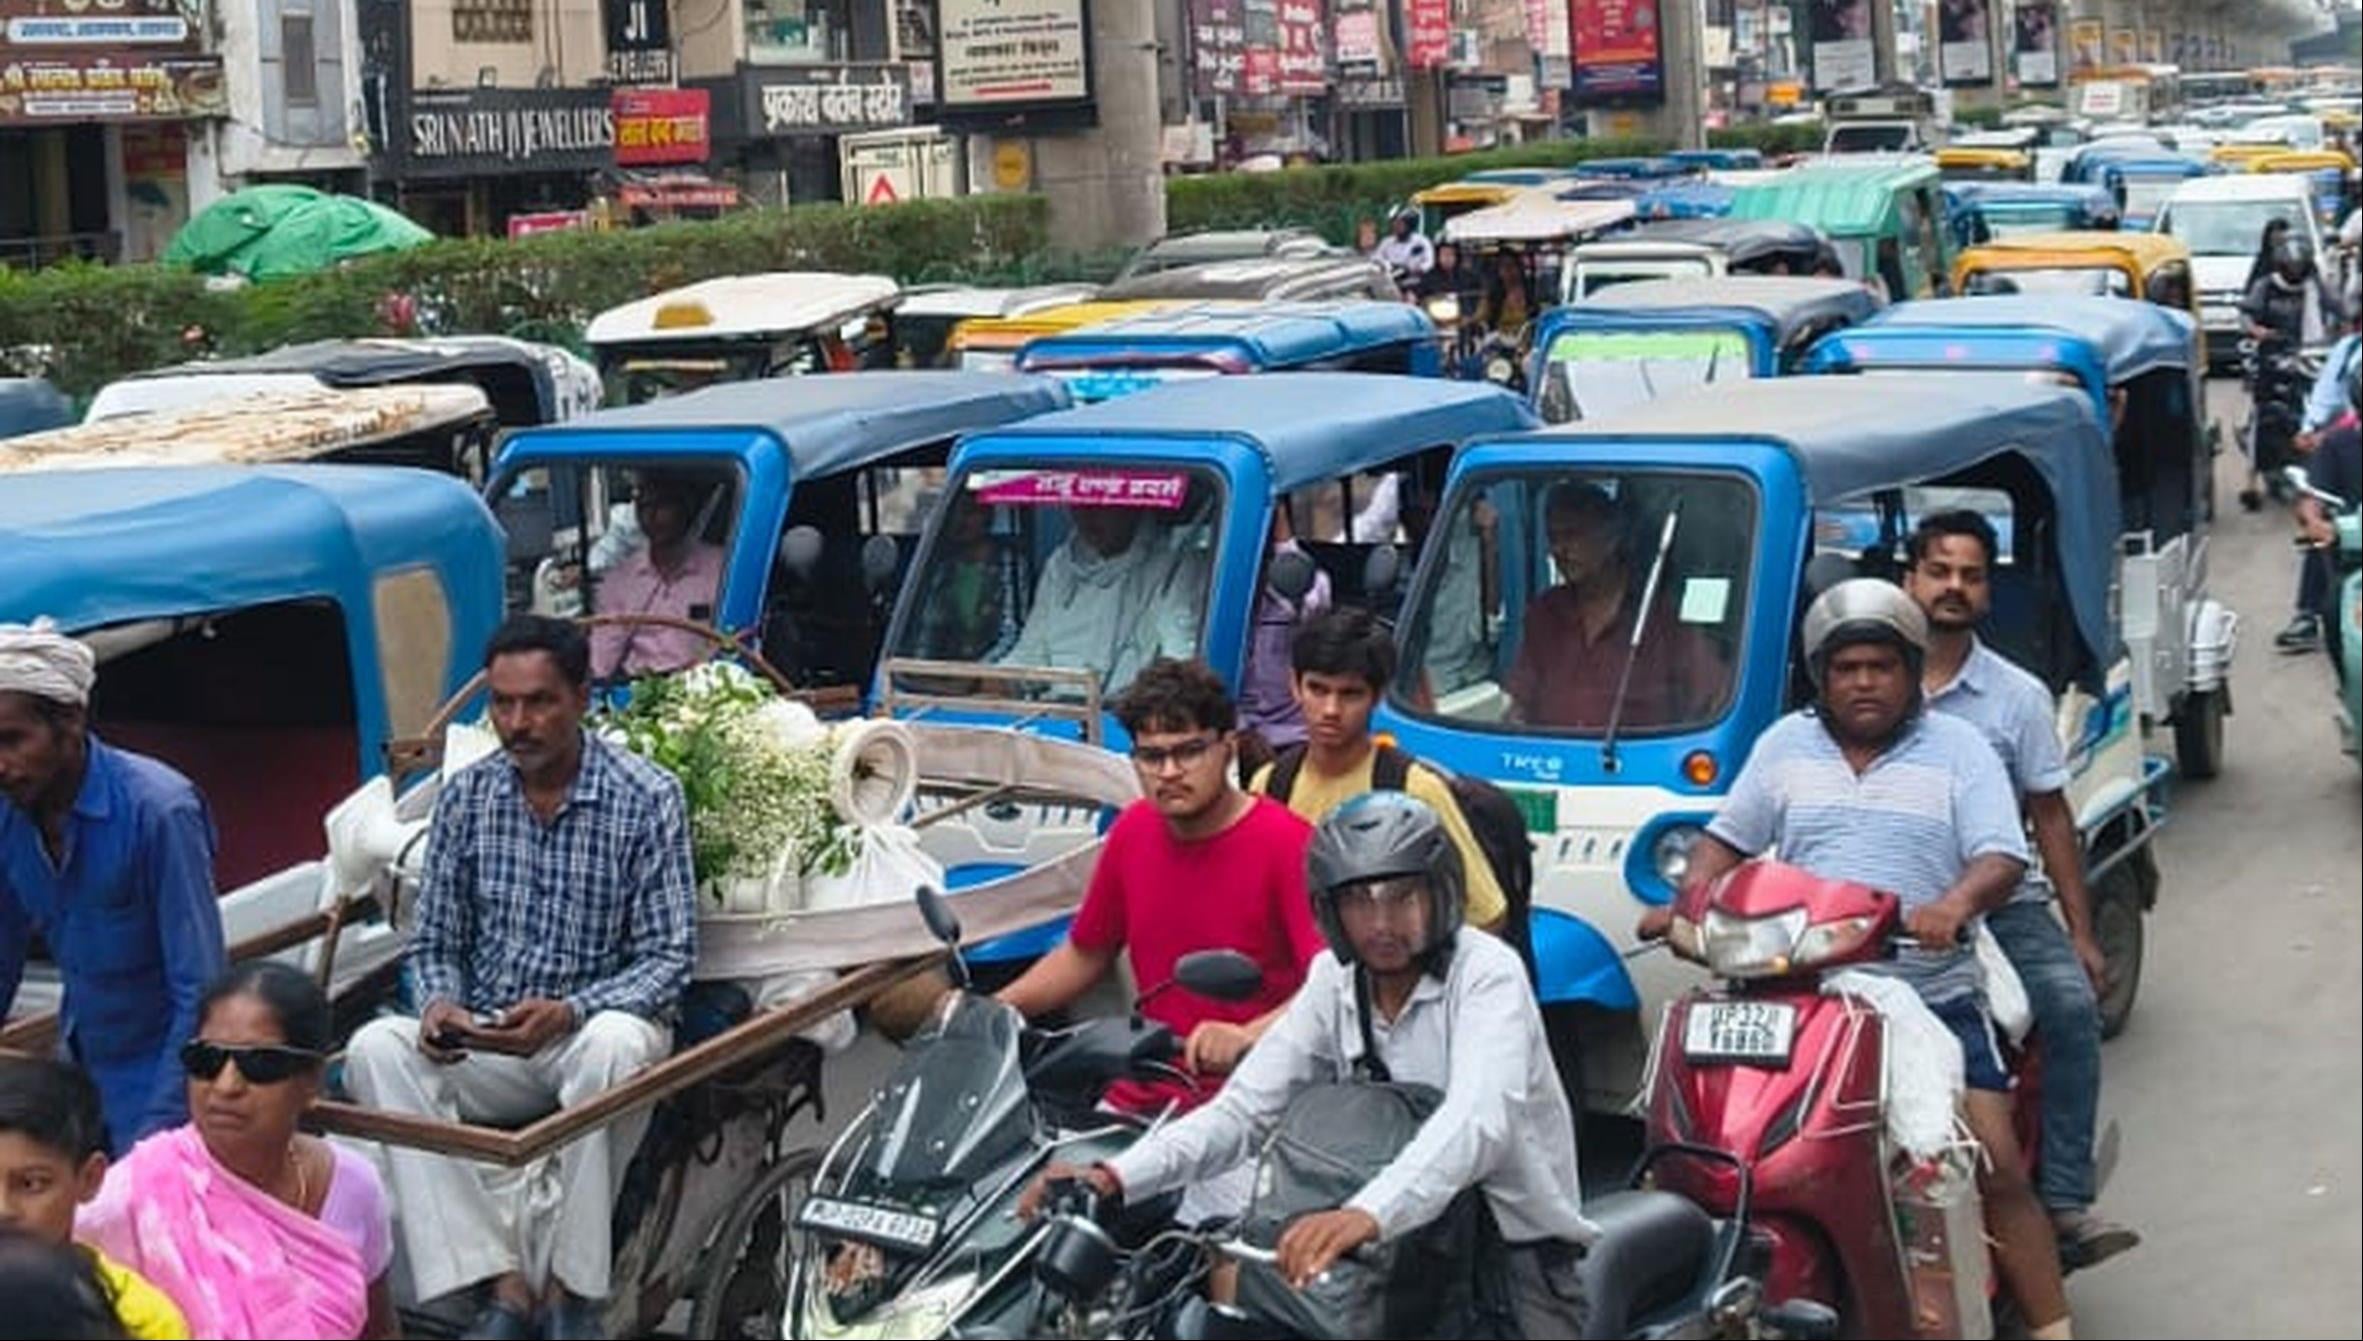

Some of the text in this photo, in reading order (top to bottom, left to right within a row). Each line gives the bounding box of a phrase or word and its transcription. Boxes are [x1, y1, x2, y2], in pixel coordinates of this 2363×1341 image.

[762, 85, 819, 132] प्रकाश
[821, 68, 863, 123] बर्तन
[864, 68, 902, 123] स्टोर
[522, 108, 615, 159] JEWELLERS
